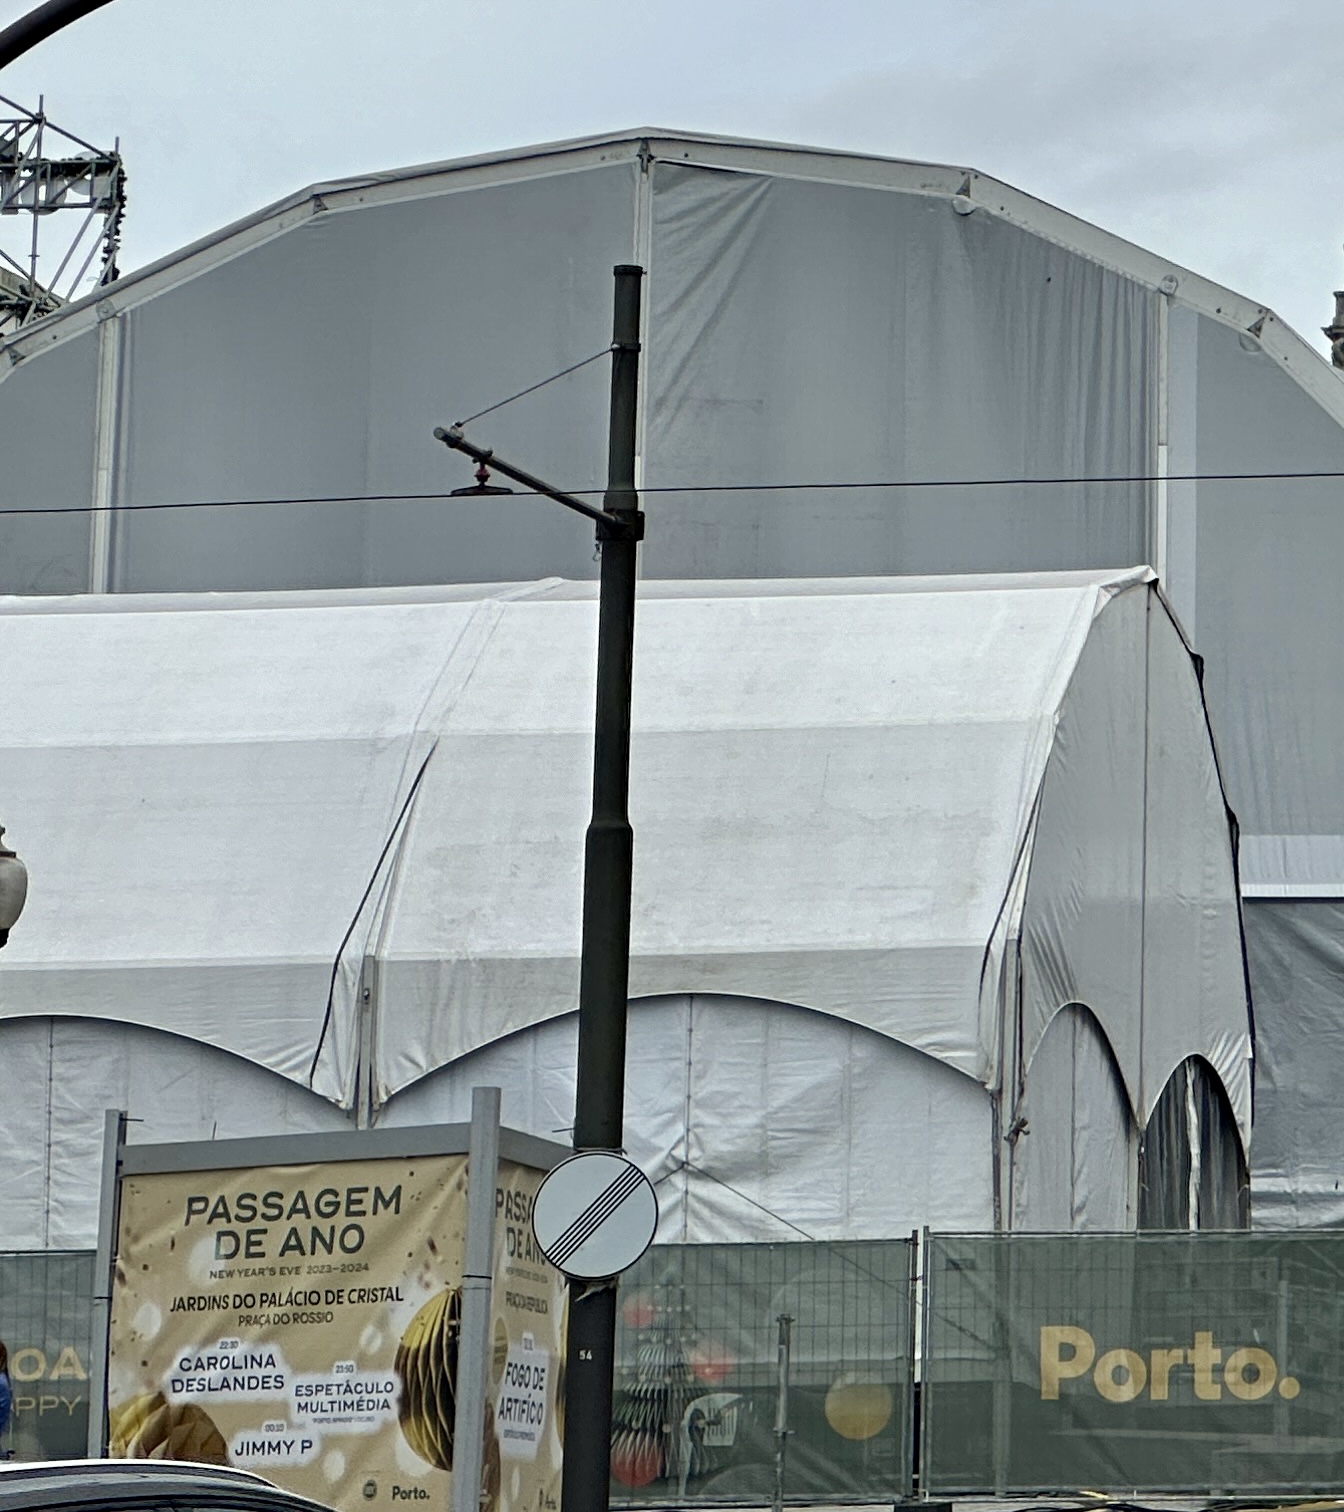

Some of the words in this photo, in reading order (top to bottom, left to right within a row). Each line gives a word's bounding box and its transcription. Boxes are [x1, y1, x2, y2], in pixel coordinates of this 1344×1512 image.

[184, 1185, 402, 1226] PASSAGEM
[214, 1228, 268, 1261] DE
[278, 1223, 365, 1258] ANO
[506, 1227, 523, 1259] DE
[209, 1269, 236, 1279] NEW
[237, 1266, 276, 1278] YEAR'S
[279, 1265, 301, 1276] EVE
[170, 1293, 229, 1313] JARDINS
[232, 1293, 256, 1309] DO
[259, 1286, 321, 1309] PALÁCIO
[324, 1289, 344, 1305] DE
[347, 1286, 404, 1304] CRISTAL
[238, 1314, 271, 1329] PRAÇA
[272, 1313, 290, 1325] DO
[292, 1311, 334, 1324] ROSSIO
[178, 1353, 277, 1372] CAROLINA
[579, 1350, 593, 1360] 54
[1040, 1325, 1300, 1404] Porto.
[171, 1374, 285, 1394] DESLANDES
[504, 1362, 531, 1389] FOGO
[532, 1366, 546, 1391] DE
[294, 1378, 394, 1397] ESPETÁCULO
[297, 1396, 392, 1414] MULTIMÉDIA
[235, 1439, 296, 1457] JIMMY
[300, 1439, 313, 1455] P
[392, 1485, 431, 1501] Porto.
